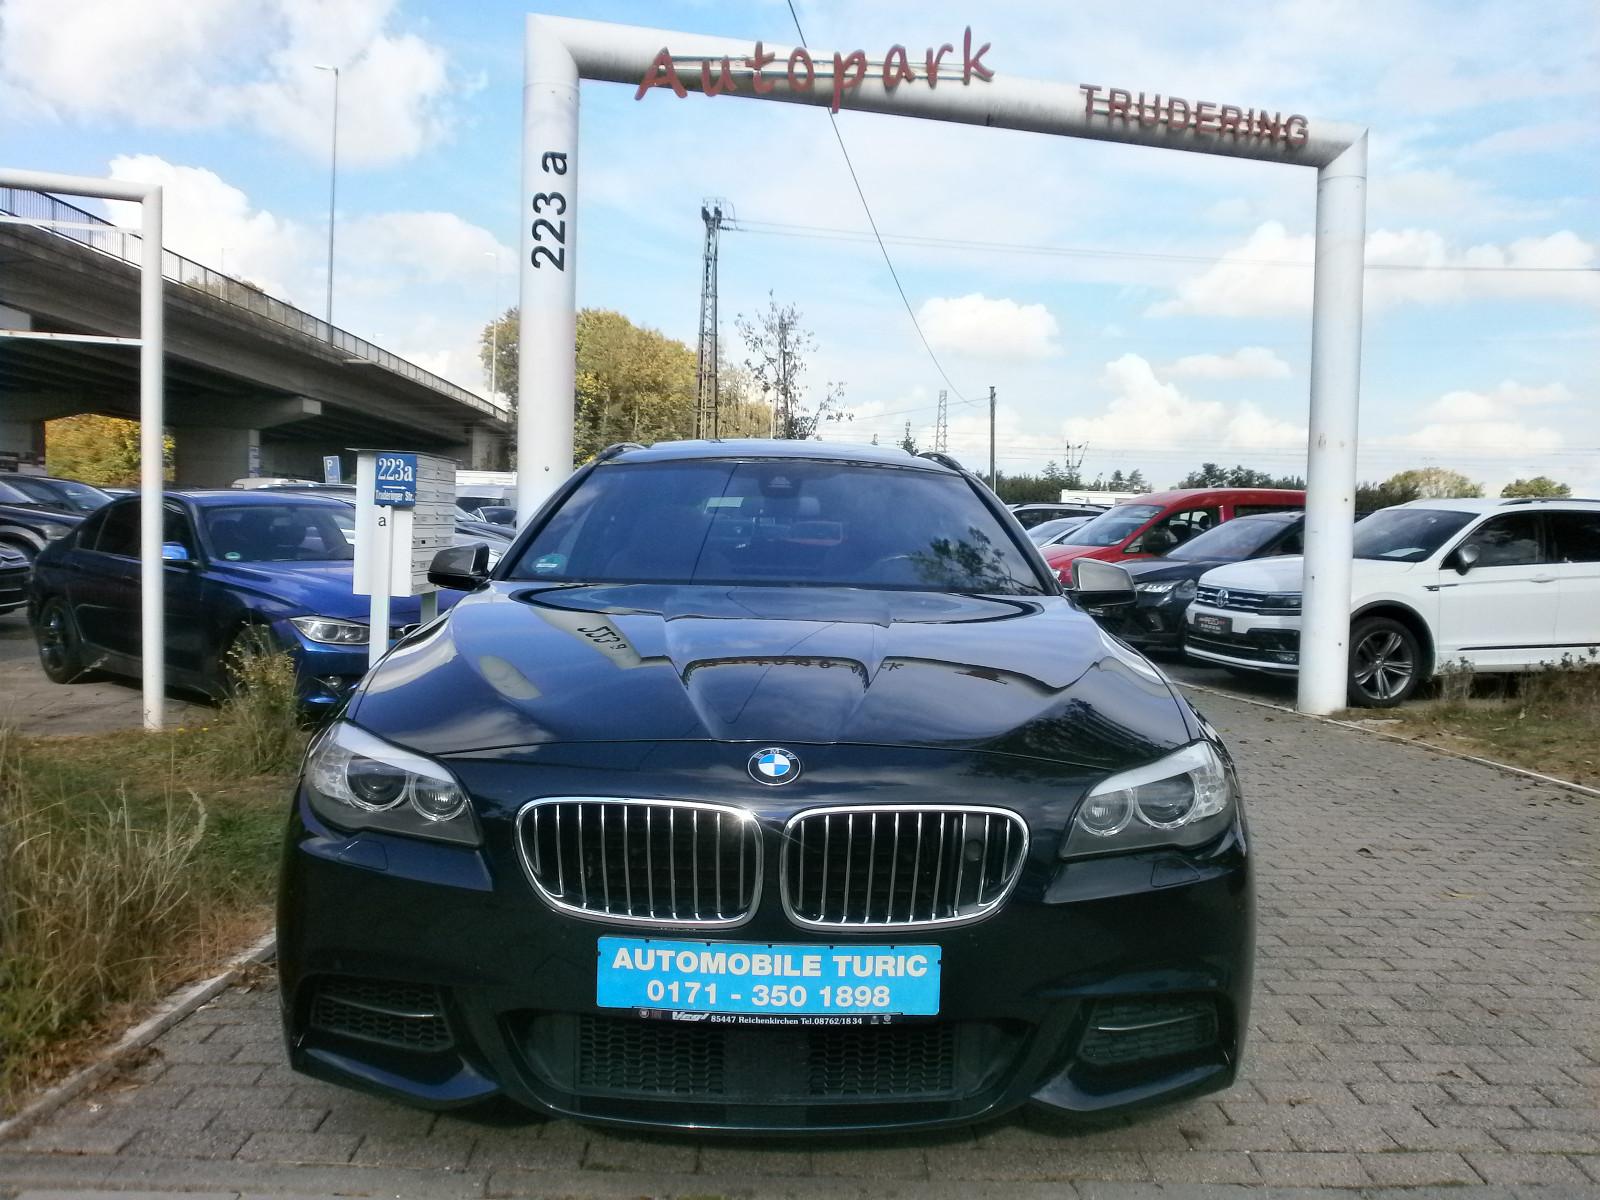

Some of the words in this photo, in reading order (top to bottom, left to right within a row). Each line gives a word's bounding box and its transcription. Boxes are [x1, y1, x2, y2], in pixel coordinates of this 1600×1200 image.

[635, 25, 995, 114] Autopark
[1080, 83, 1309, 146] TRUDERING
[542, 151, 567, 175] a
[531, 192, 567, 272] 223
[378, 458, 413, 482] 223a
[378, 516, 386, 526] a
[612, 947, 822, 977] AUTOMOBILE
[832, 955, 928, 978] TURIC
[647, 979, 717, 1005] 0171
[751, 984, 807, 1007] 350
[819, 985, 890, 1008] 1898
[711, 1015, 736, 1023] 85447
[738, 1016, 799, 1025] Reichenkirchen
